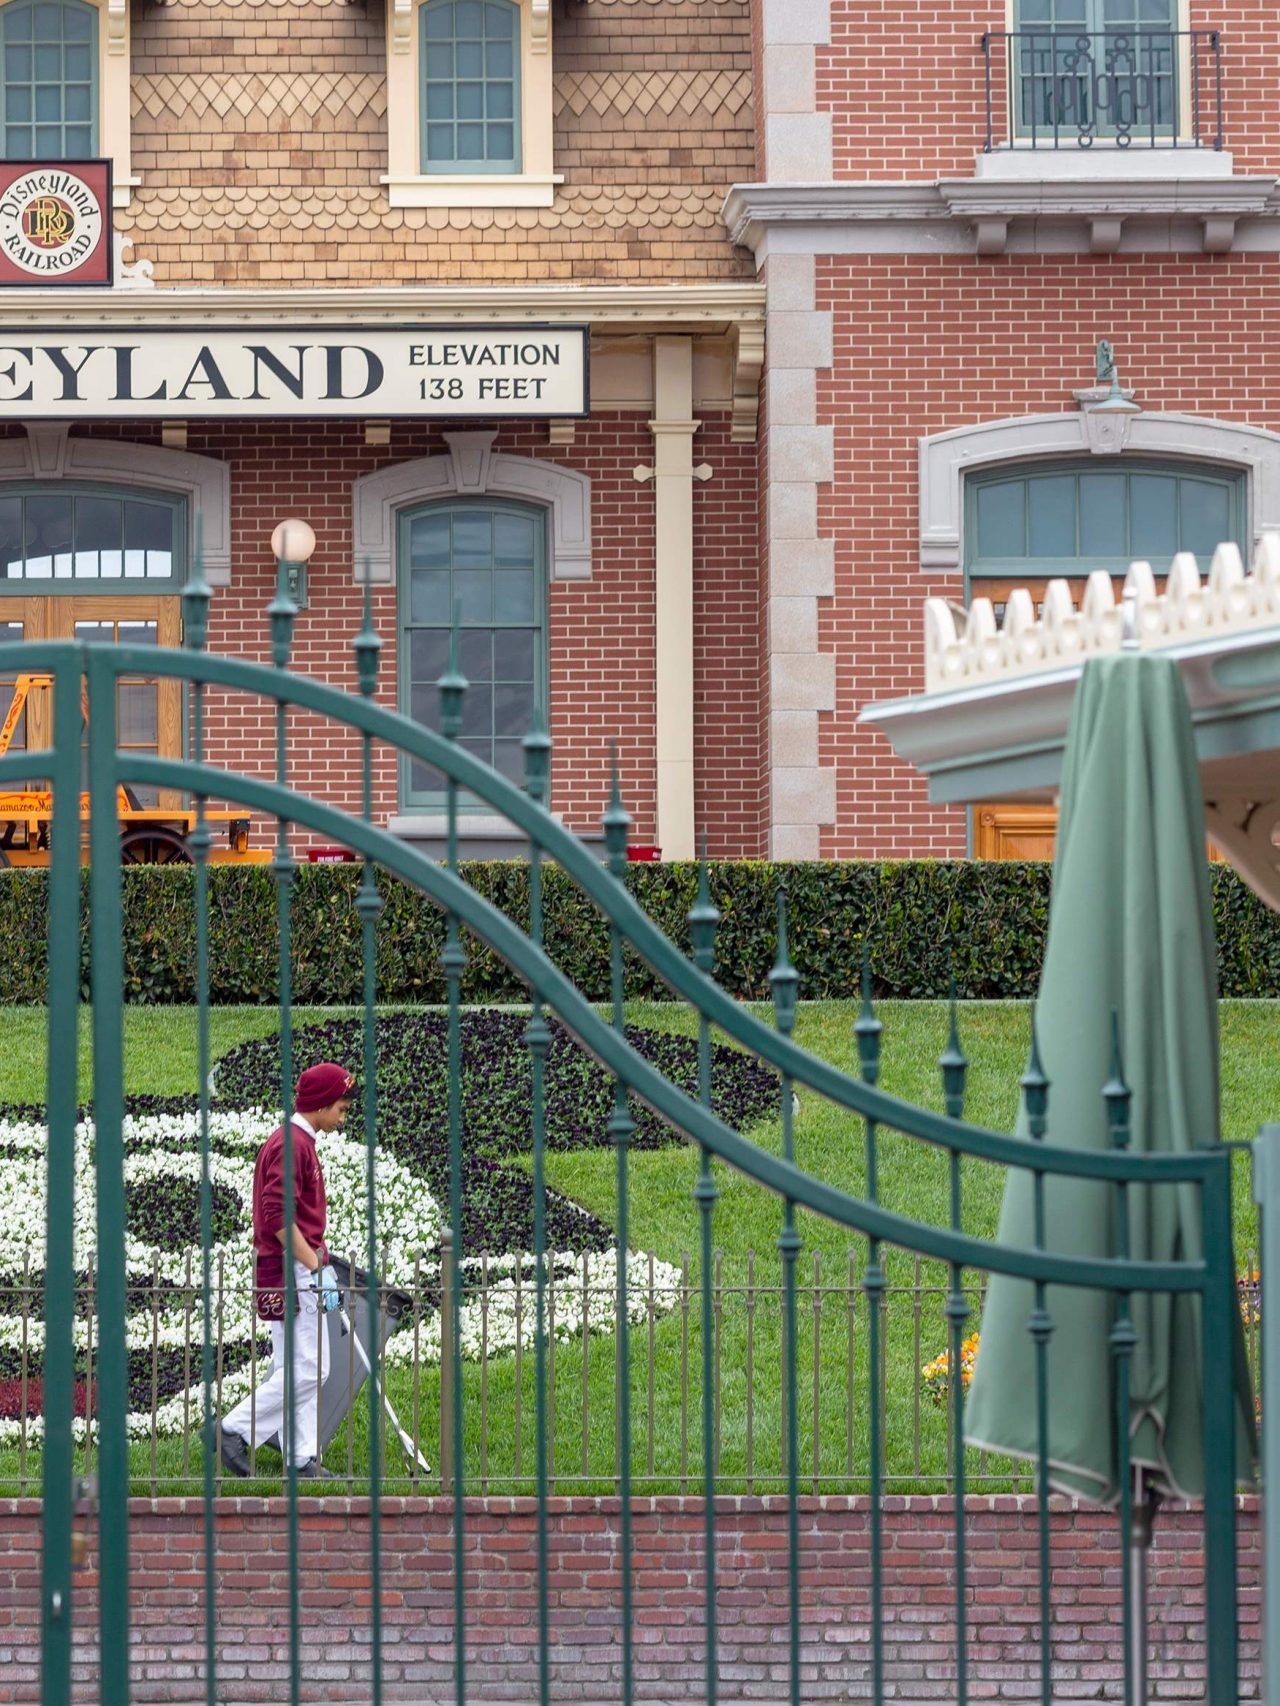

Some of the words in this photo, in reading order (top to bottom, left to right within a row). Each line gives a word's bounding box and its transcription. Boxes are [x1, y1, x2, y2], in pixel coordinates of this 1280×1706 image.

[0, 174, 99, 220] Disneyland
[4, 234, 91, 270] RAILROAD
[409, 344, 560, 366] ELEVATION
[419, 378, 464, 400] 138
[478, 378, 547, 400] FEET
